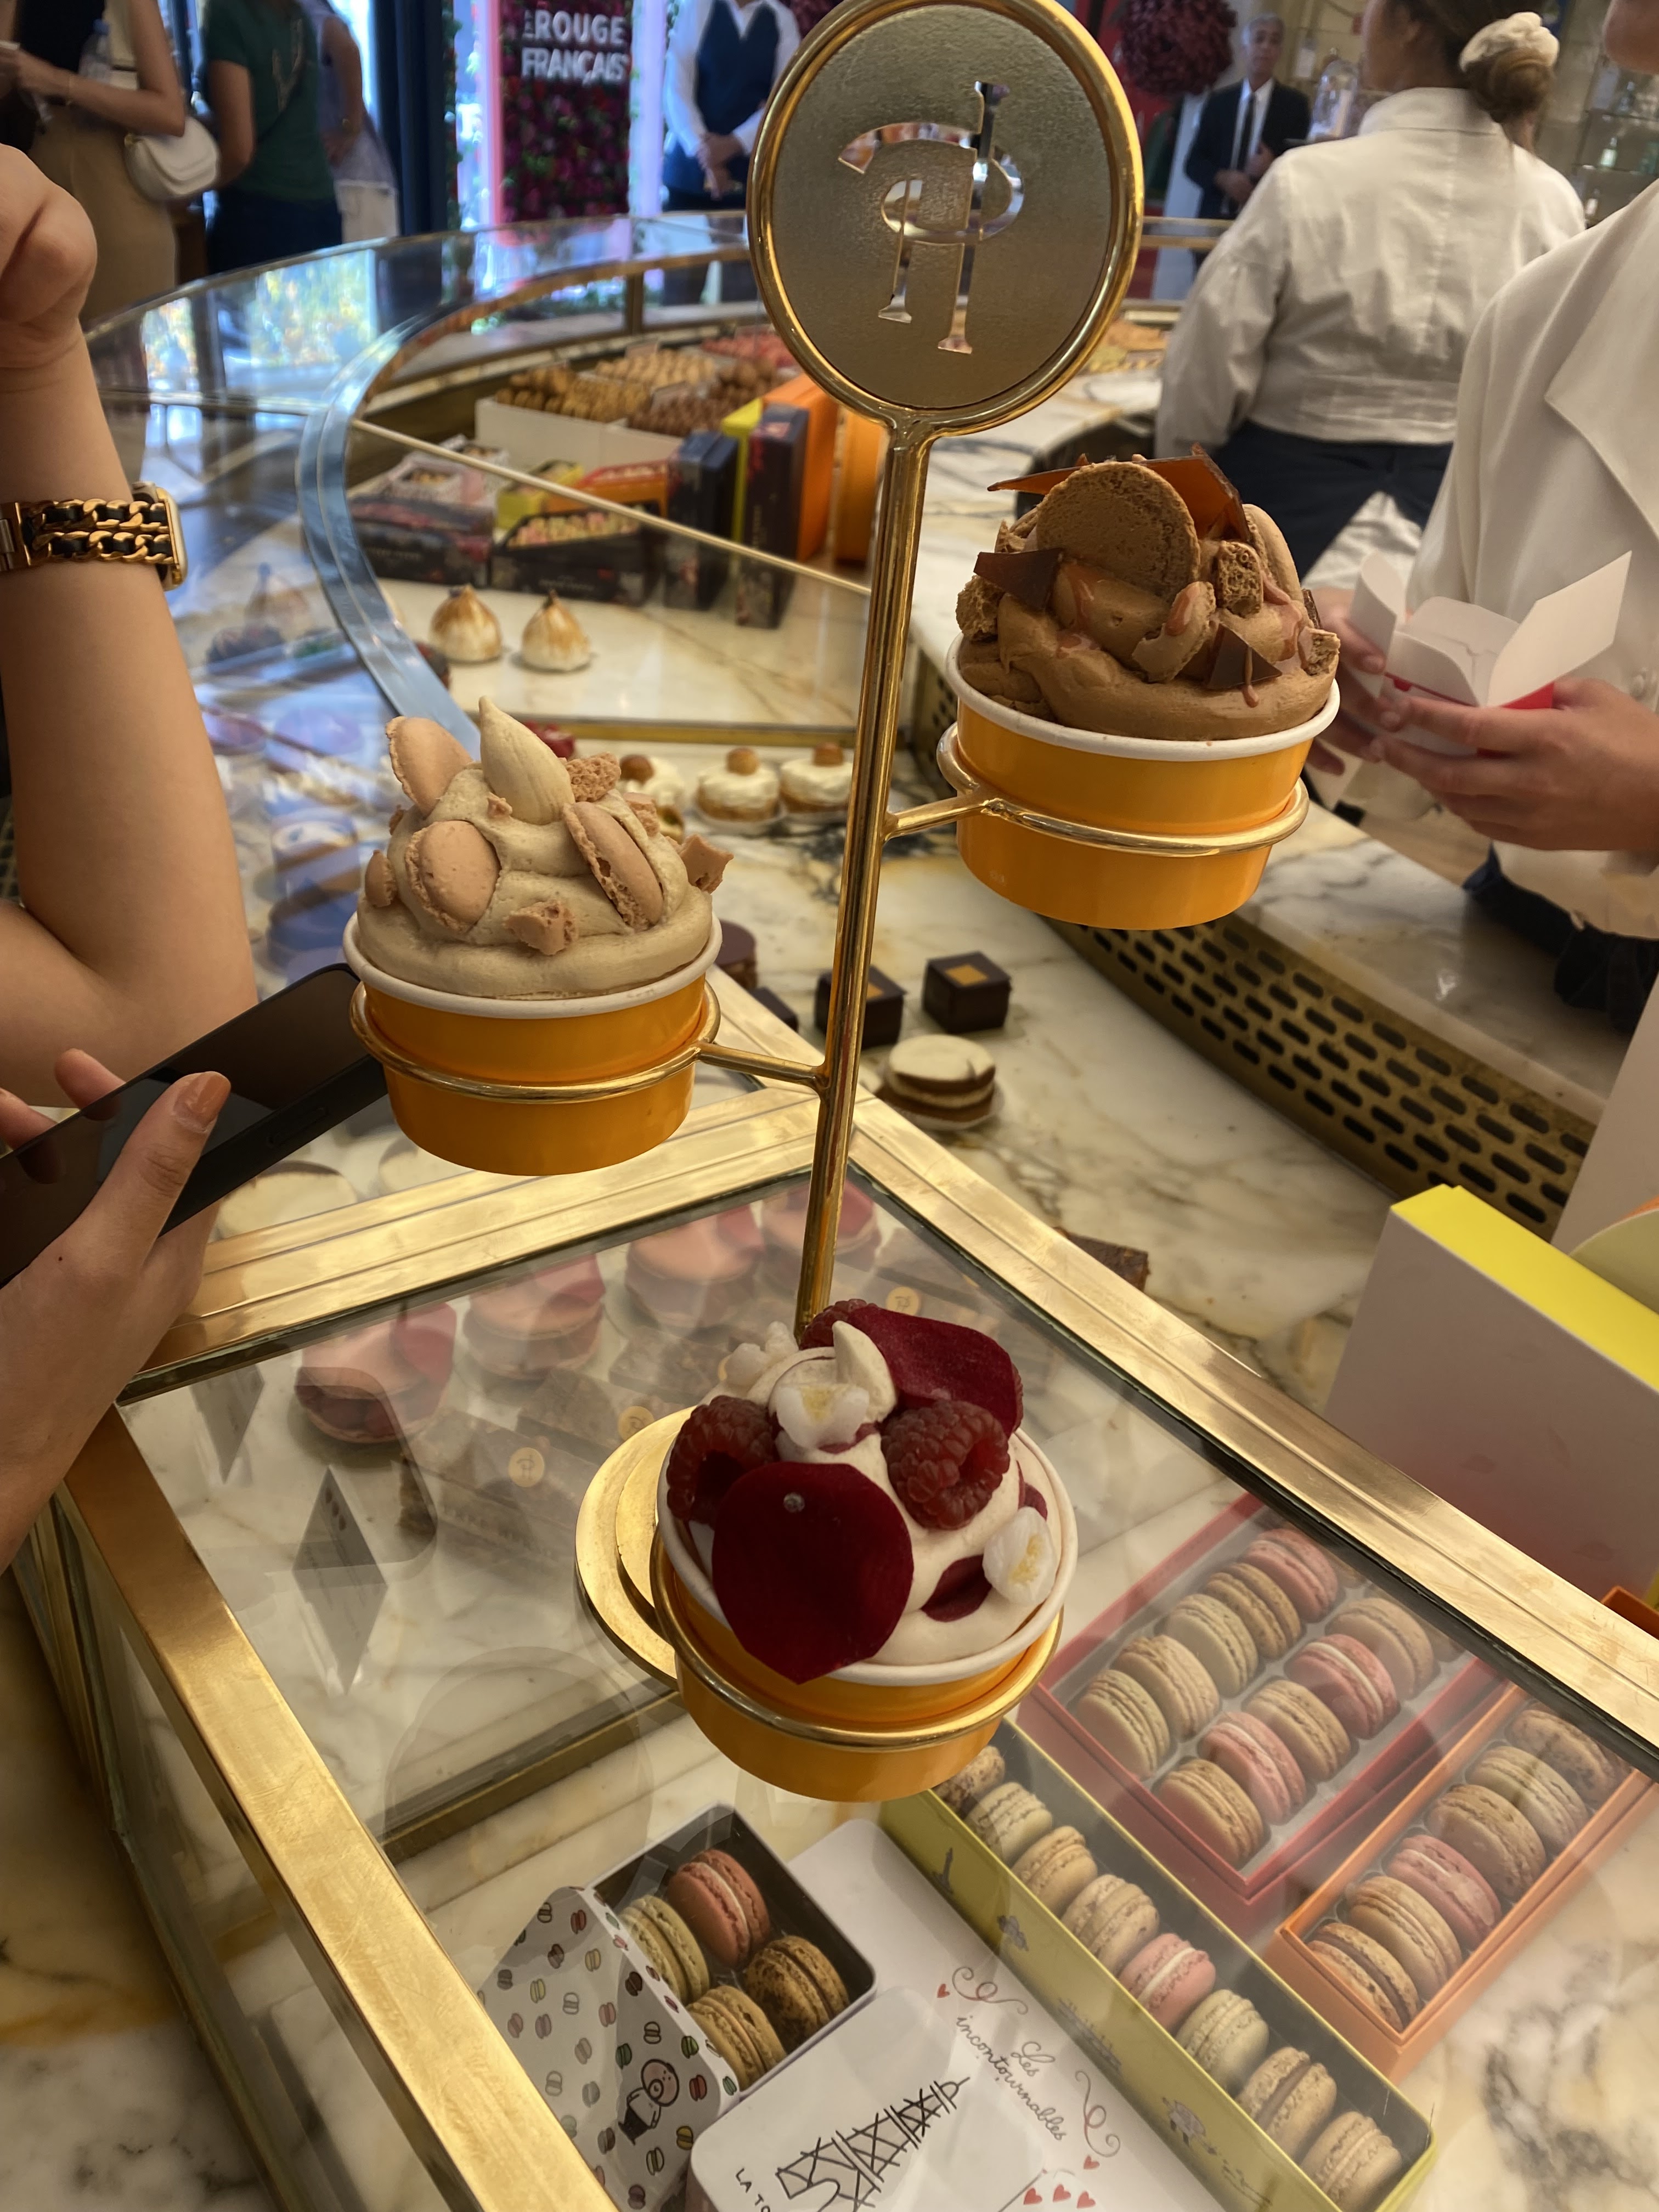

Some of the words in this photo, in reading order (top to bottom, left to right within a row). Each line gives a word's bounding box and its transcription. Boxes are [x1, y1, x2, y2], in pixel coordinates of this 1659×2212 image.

[535, 9, 625, 45] ROUGE
[1011, 2041, 1056, 2076] Les
[956, 2015, 1066, 2141] incontournables
[735, 2168, 752, 2193] LA
